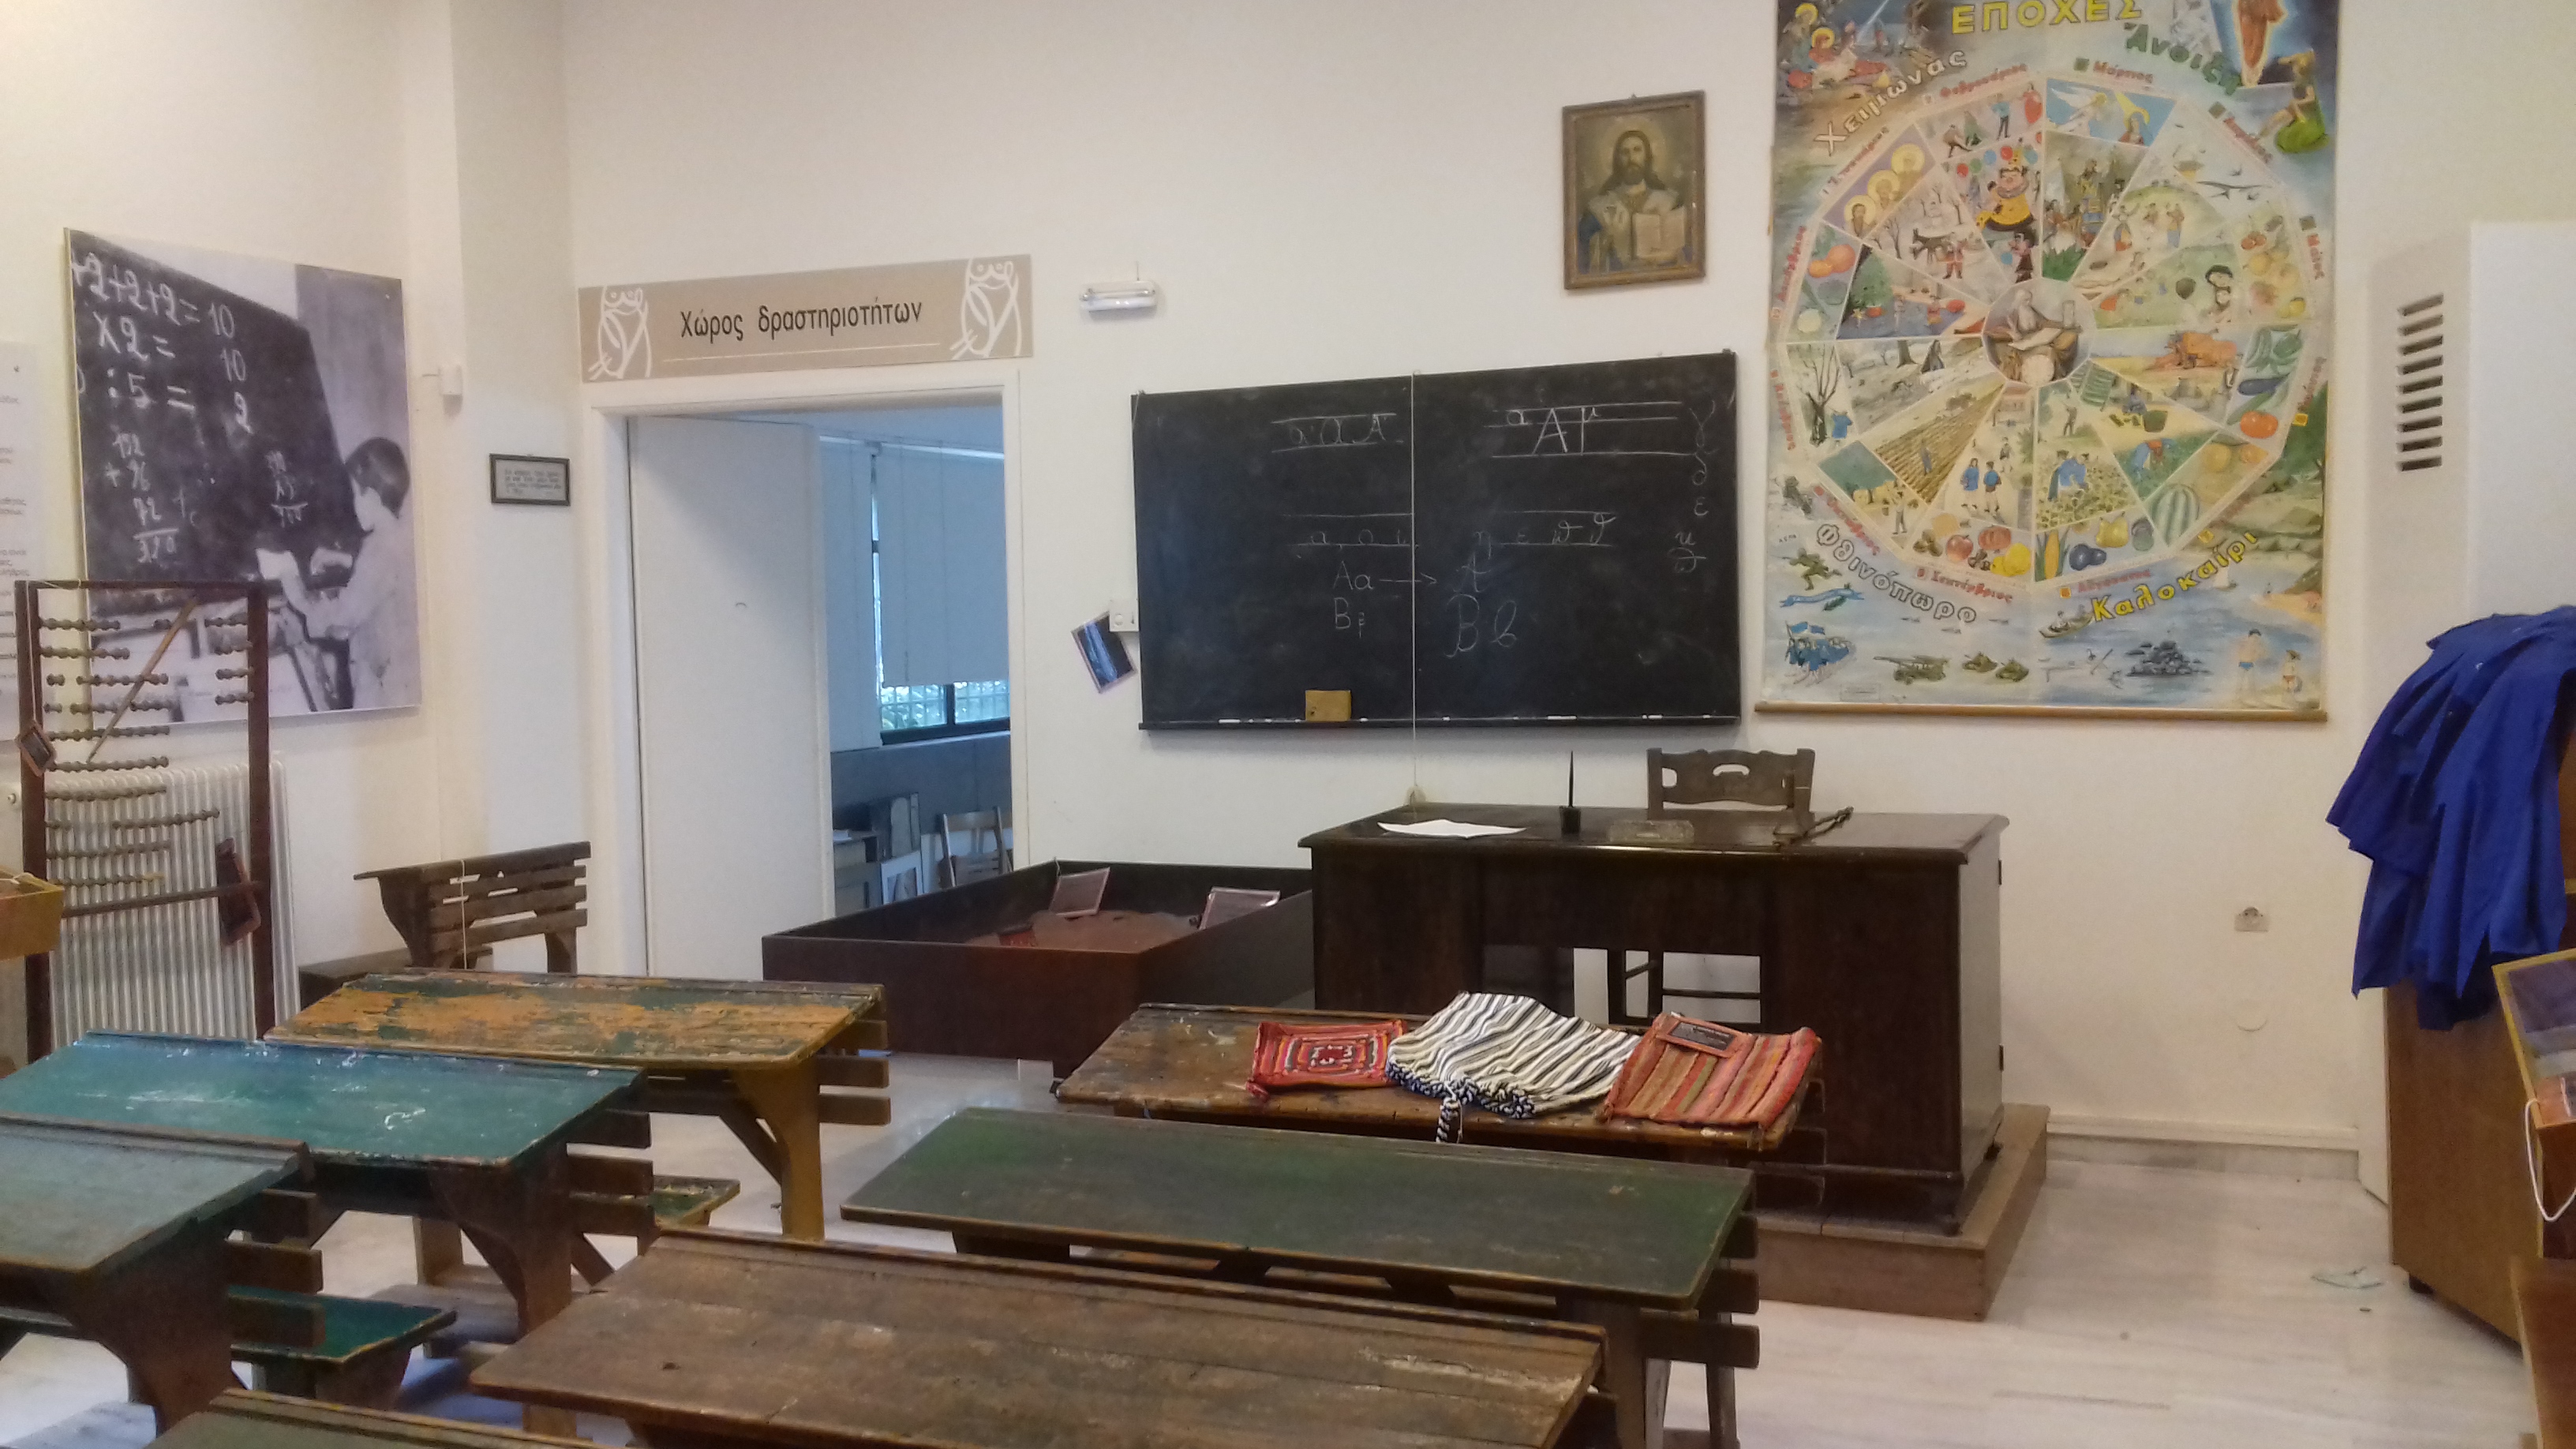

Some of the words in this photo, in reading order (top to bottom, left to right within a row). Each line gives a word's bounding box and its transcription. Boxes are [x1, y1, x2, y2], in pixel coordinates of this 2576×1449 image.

[1952, 0, 2142, 34] ΕΠΟΧΕΣ
[680, 308, 743, 343] Χώρος
[758, 297, 922, 340] δραστηριοτήτων
[1817, 523, 1977, 623] Φθινόπωρο
[2091, 531, 2257, 622] Καλοκαίρι
